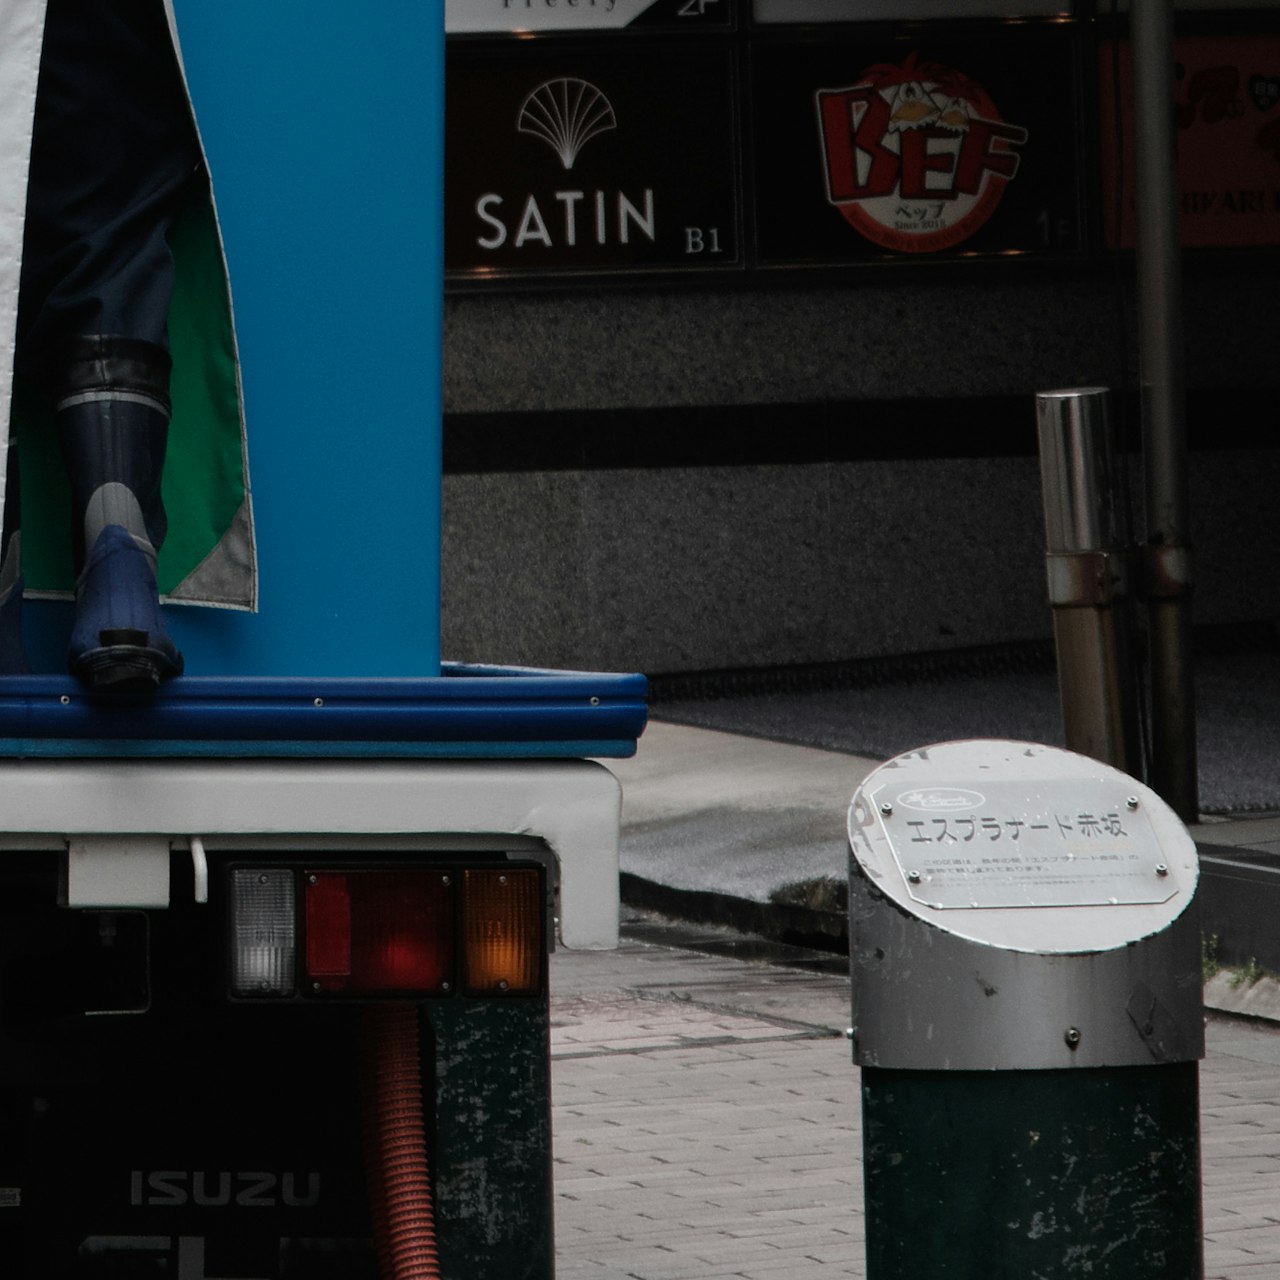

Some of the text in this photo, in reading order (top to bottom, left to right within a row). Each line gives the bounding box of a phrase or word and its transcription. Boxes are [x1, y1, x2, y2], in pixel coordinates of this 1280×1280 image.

[815, 85, 1029, 205] BEF
[475, 188, 656, 251] SATIN
[895, 202, 946, 220] ベップ
[684, 227, 723, 254] B1
[906, 811, 1129, 843] エスプラナード赤坂
[131, 1170, 321, 1206] ISUZU
